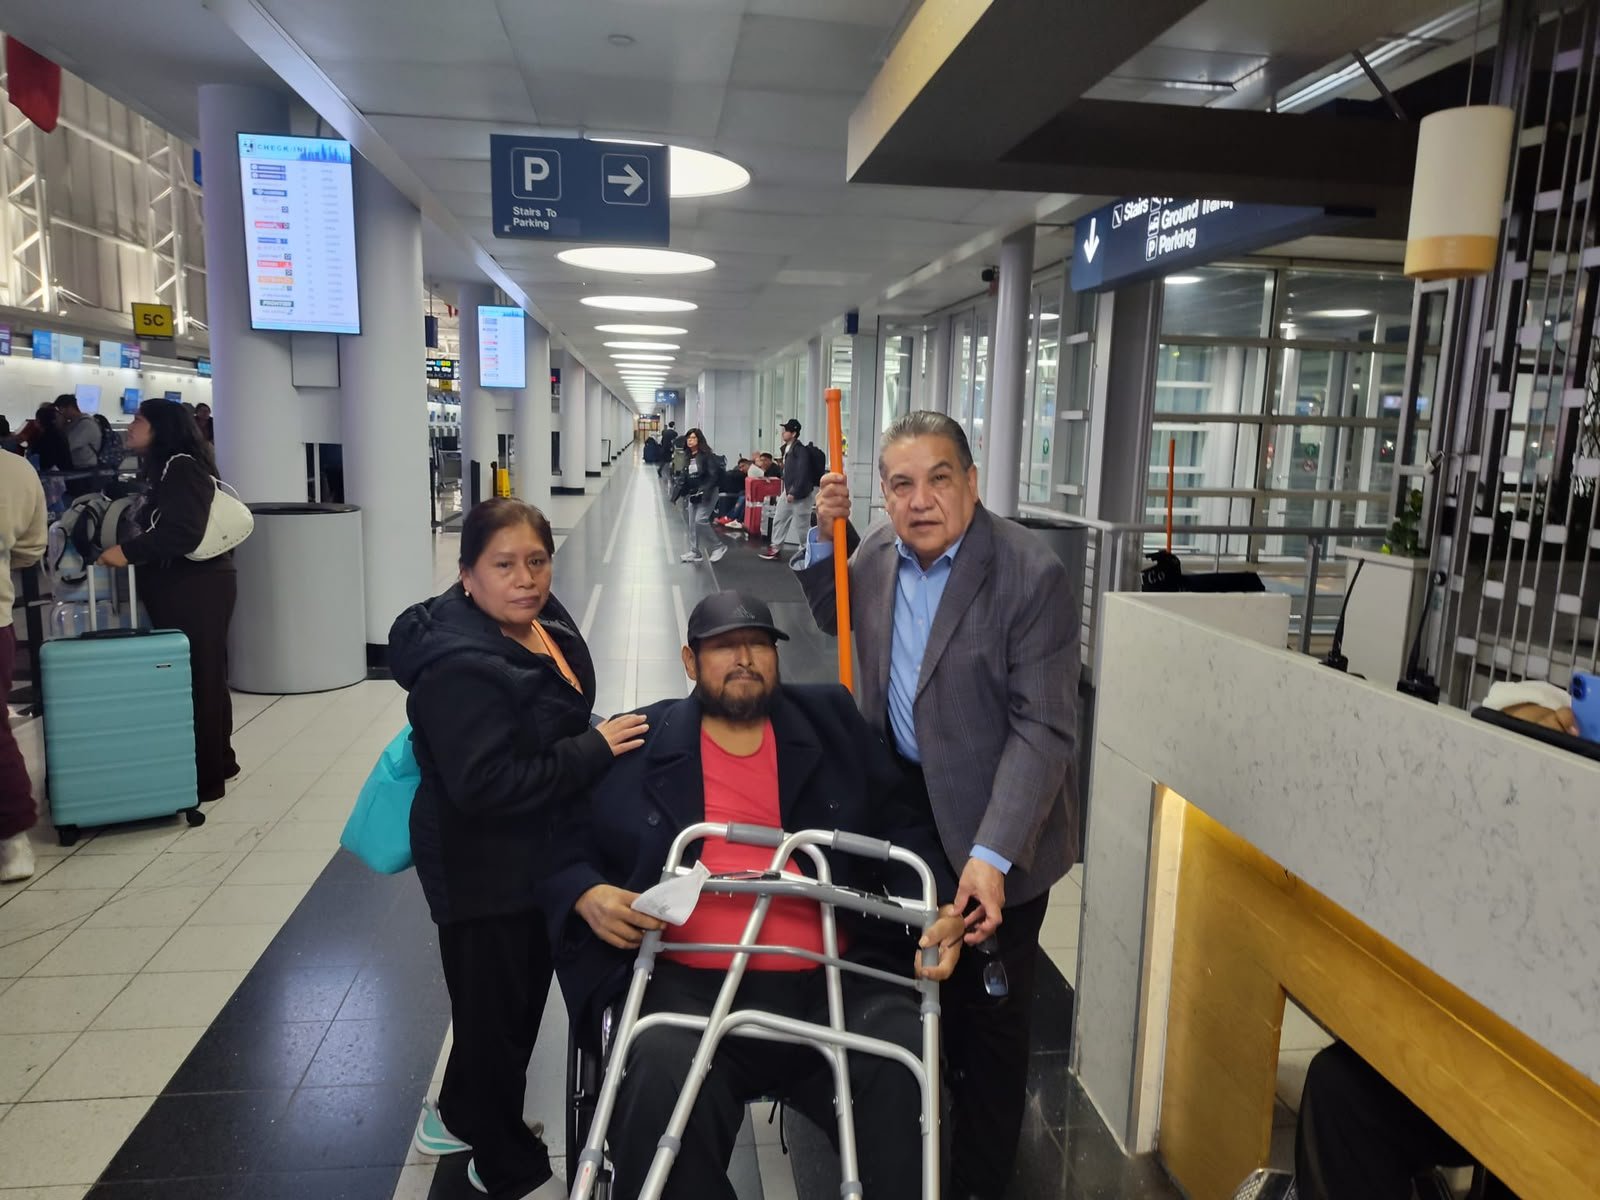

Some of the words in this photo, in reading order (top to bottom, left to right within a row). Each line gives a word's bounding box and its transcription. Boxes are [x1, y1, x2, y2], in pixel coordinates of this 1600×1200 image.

[523, 156, 550, 192] P
[512, 206, 541, 217] Stairs
[545, 208, 557, 218] To
[1123, 197, 1149, 222] Stairs
[1161, 199, 1199, 230] Ground
[513, 217, 549, 230] Parking
[1148, 240, 1155, 258] P
[1158, 227, 1197, 255] Parking
[143, 314, 164, 327] 5C
